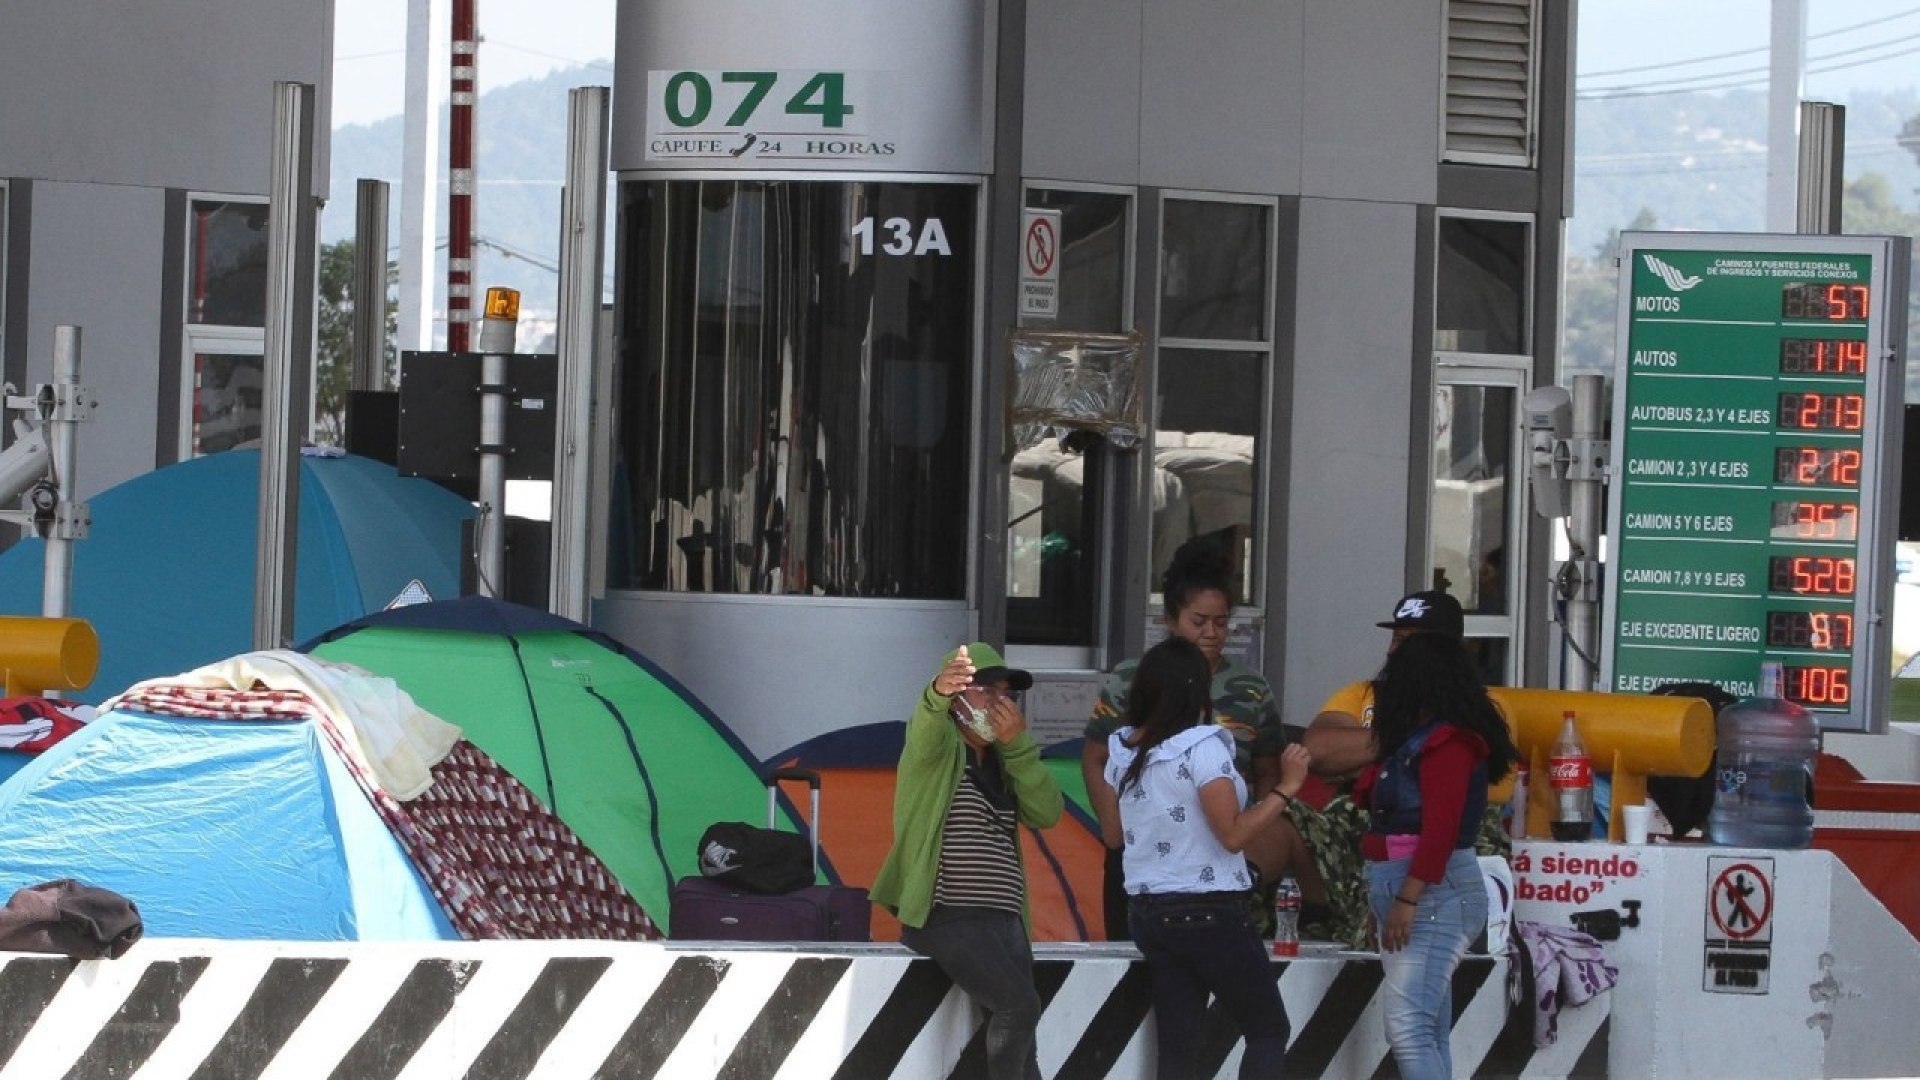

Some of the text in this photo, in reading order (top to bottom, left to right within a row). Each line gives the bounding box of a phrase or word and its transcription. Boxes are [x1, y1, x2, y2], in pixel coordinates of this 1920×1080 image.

[664, 71, 854, 127] 074
[651, 140, 895, 155] CAPUFE 24 HORAS
[852, 216, 952, 256] 13A
[1706, 267, 1718, 275] DE
[1720, 268, 1762, 277] INGRESOS
[1772, 269, 1815, 278] SERVICIOS
[1817, 270, 1858, 279] CONEXOS
[1715, 259, 1752, 268] CAMINOS
[1762, 261, 1800, 269] PUENTES
[1801, 261, 1850, 271] FEDERALES
[1635, 296, 1681, 312] MOTOS
[1827, 284, 1869, 319] 57
[1633, 350, 1678, 367] AUTOS
[1815, 340, 1867, 373] 114
[1631, 406, 1693, 422] AUTOBUS
[1716, 408, 1726, 423] Y
[1727, 408, 1736, 423] 4
[1738, 409, 1771, 424] EJES
[1800, 393, 1864, 429] 213
[1628, 458, 1675, 476] CAMION
[1699, 461, 1709, 476] Y
[1709, 461, 1718, 477] 4
[1719, 462, 1749, 478] EJES
[1798, 448, 1860, 484] 212
[1625, 513, 1734, 532] CAMION 5 Y 6 EJES
[1799, 503, 1858, 537] 357
[1623, 569, 1746, 588] CAMION 7,8 Y 9 EJES
[1793, 558, 1855, 594] 528
[1621, 622, 1760, 642] EJE EXCEDENTE LIGERO
[1619, 675, 1640, 691] EJE
[1801, 668, 1848, 703] 106
[1541, 851, 1638, 878] siendo
[1513, 876, 1604, 904] bado”
